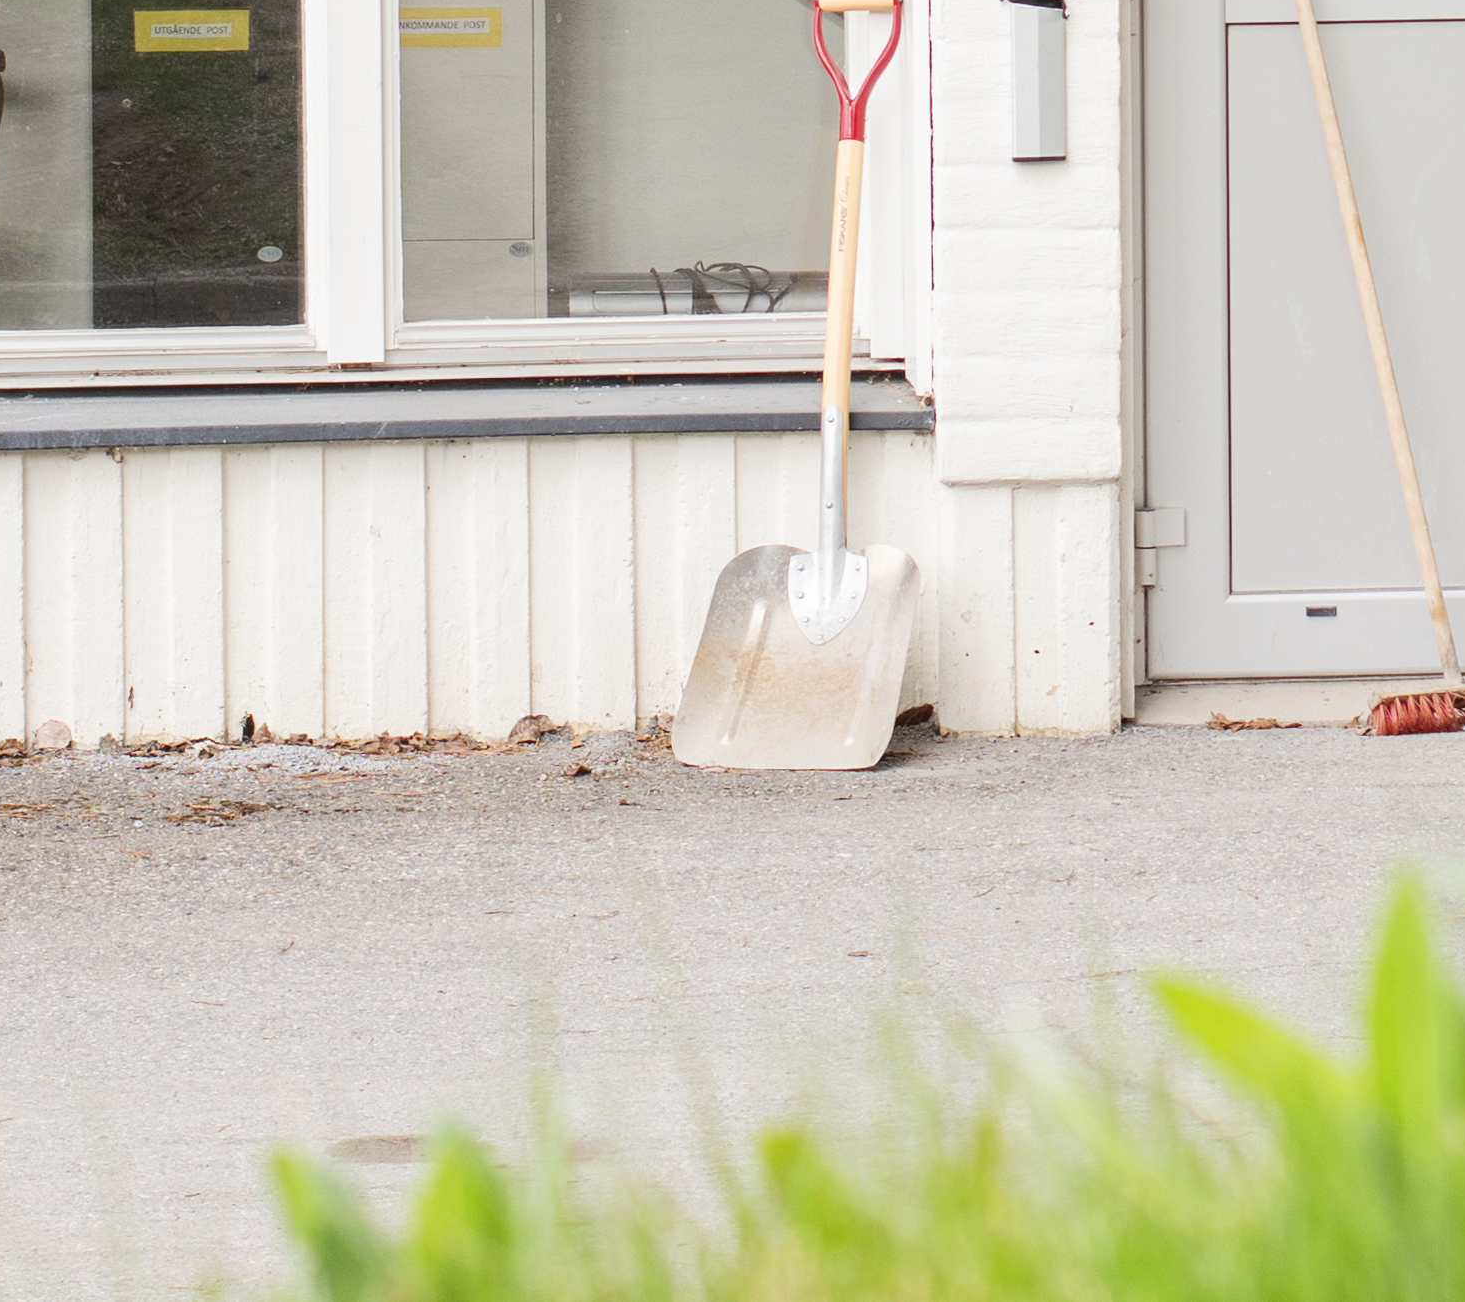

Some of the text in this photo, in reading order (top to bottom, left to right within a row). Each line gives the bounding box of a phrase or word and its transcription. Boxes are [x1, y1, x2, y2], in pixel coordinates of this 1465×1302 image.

[155, 24, 229, 36] UTGÅENDE POST
[399, 20, 486, 30] NKOMMANDE POST
